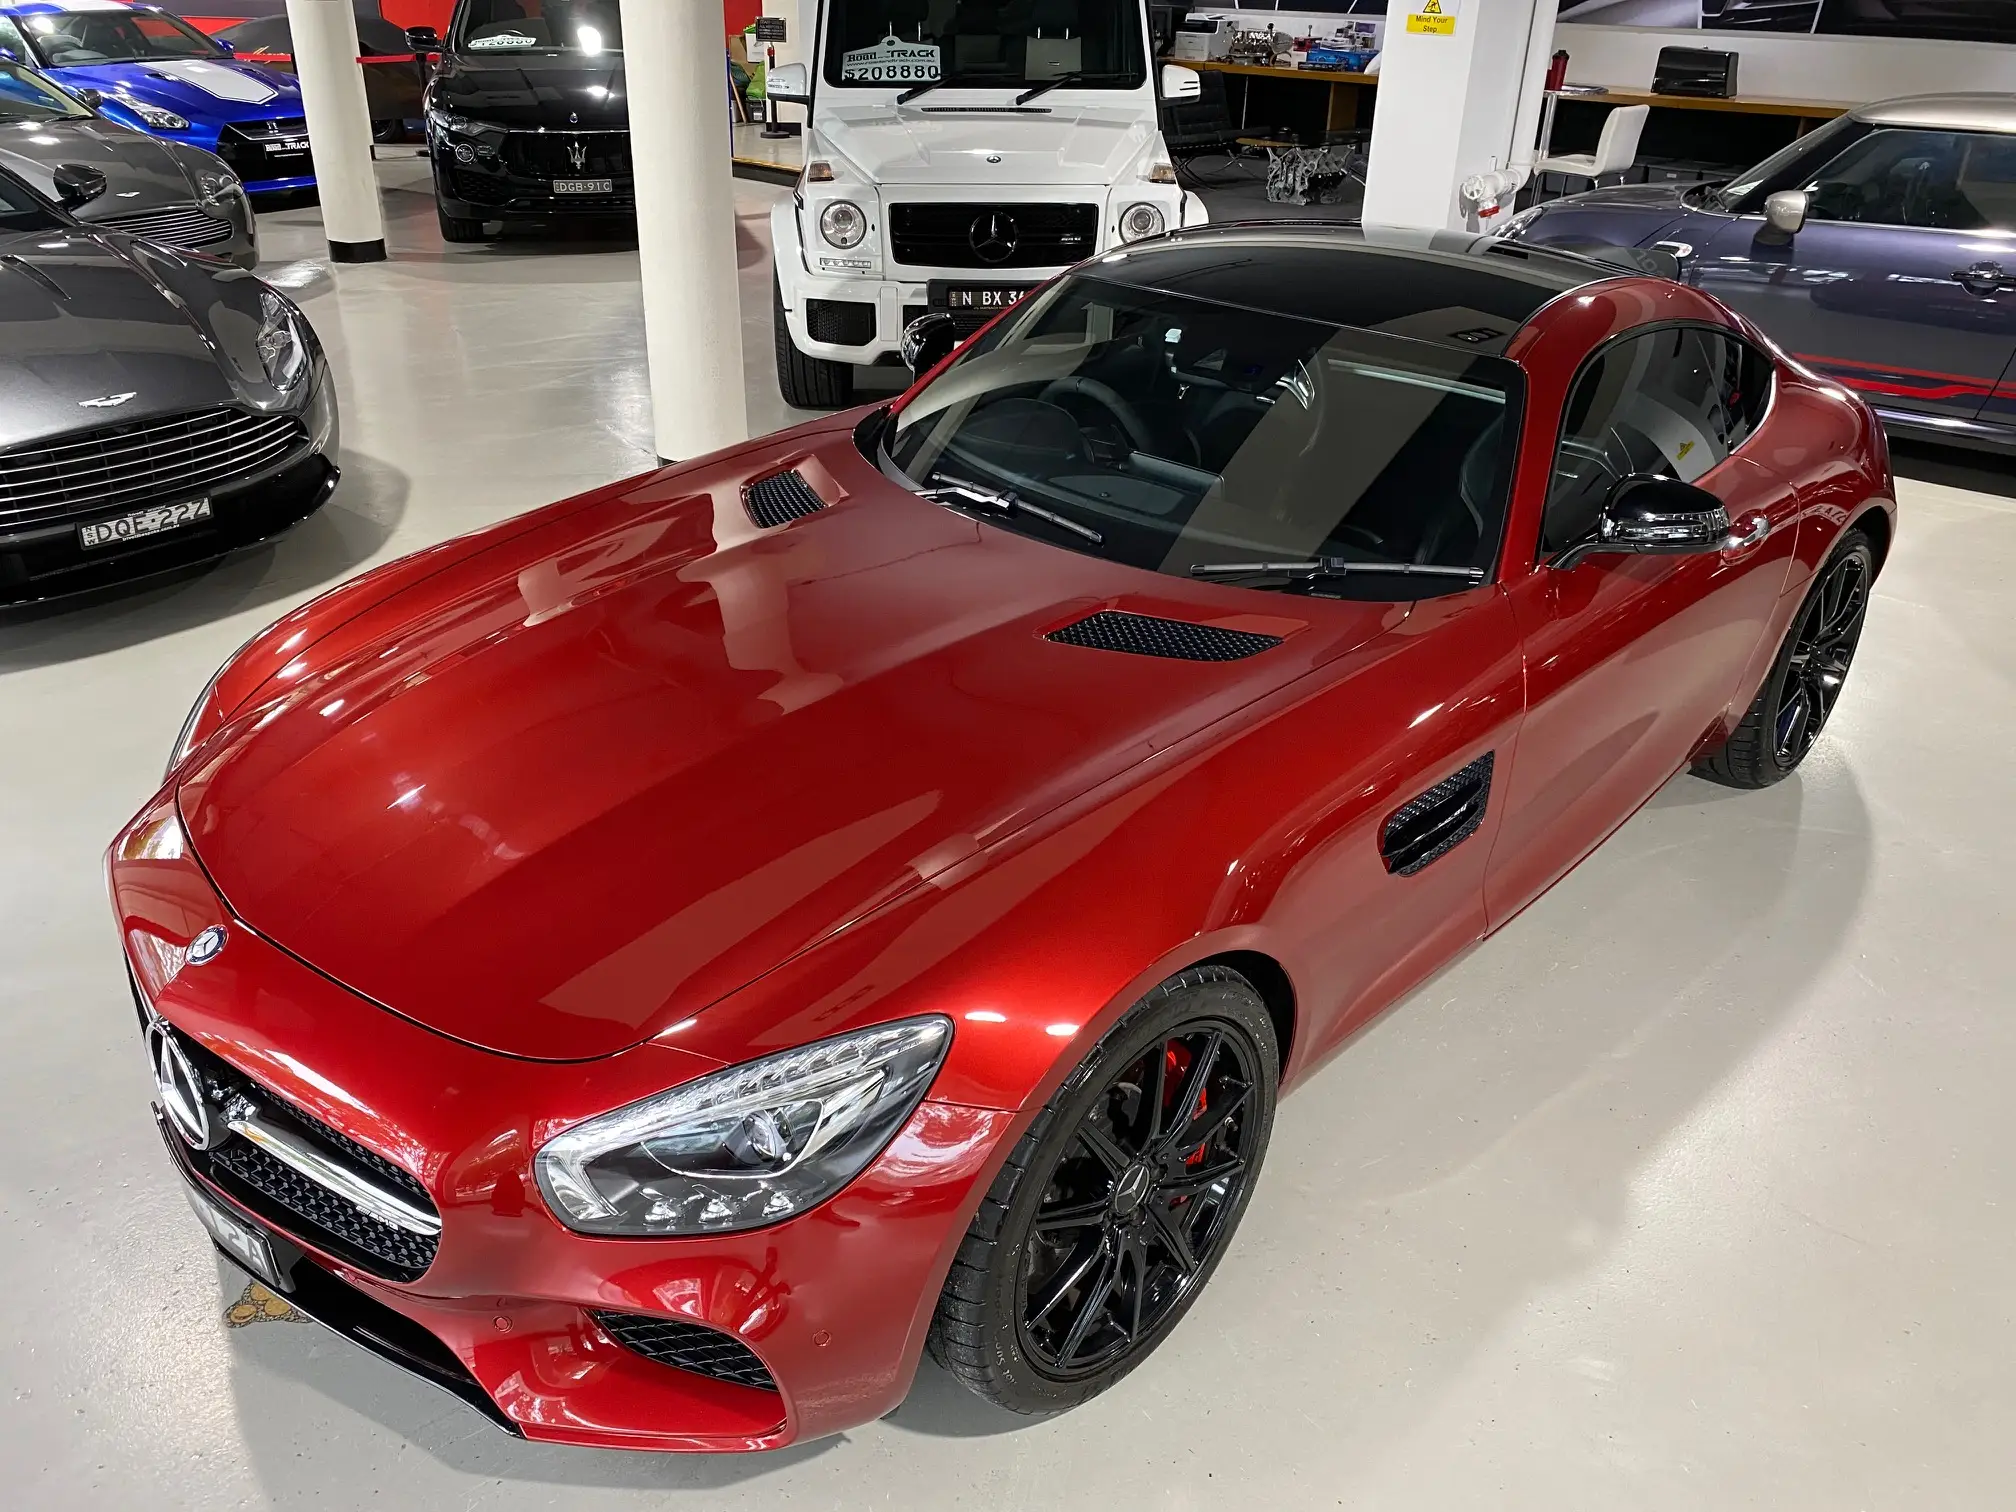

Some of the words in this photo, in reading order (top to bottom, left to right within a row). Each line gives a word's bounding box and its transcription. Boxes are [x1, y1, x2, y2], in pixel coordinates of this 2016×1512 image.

[1422, 25, 1437, 33] Step
[886, 49, 935, 58] TRACK
[844, 65, 939, 80] $208880
[962, 291, 972, 305] N
[982, 291, 1002, 305] BX
